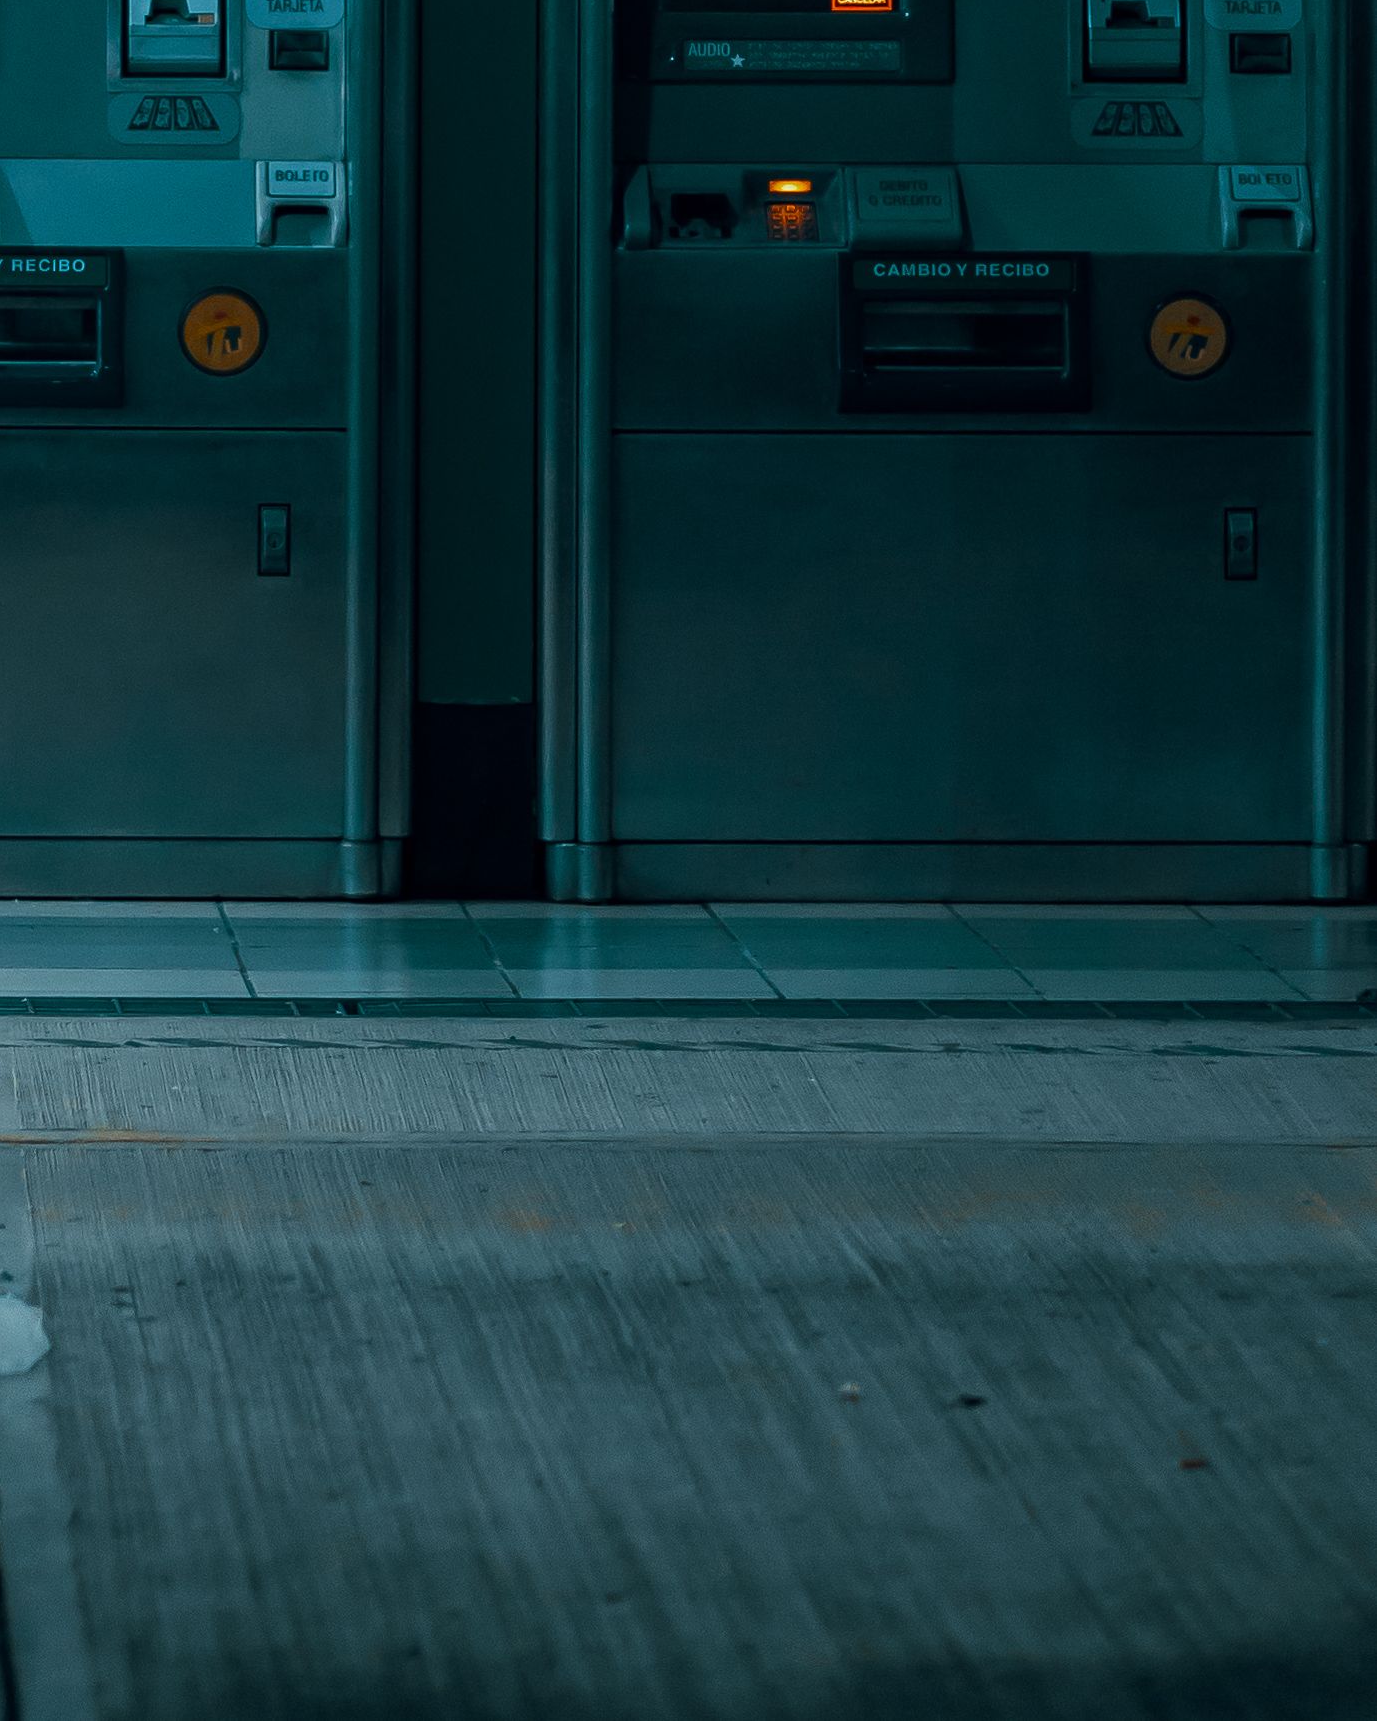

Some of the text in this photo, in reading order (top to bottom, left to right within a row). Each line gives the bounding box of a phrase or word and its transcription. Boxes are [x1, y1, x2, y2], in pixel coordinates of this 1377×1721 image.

[1225, 0, 1283, 15] TARJETA
[688, 41, 731, 57] AUDIO
[275, 169, 329, 182] BOLETO
[11, 258, 86, 273] RECIBO
[873, 262, 1050, 278] CAMBIO Y RECIBO
